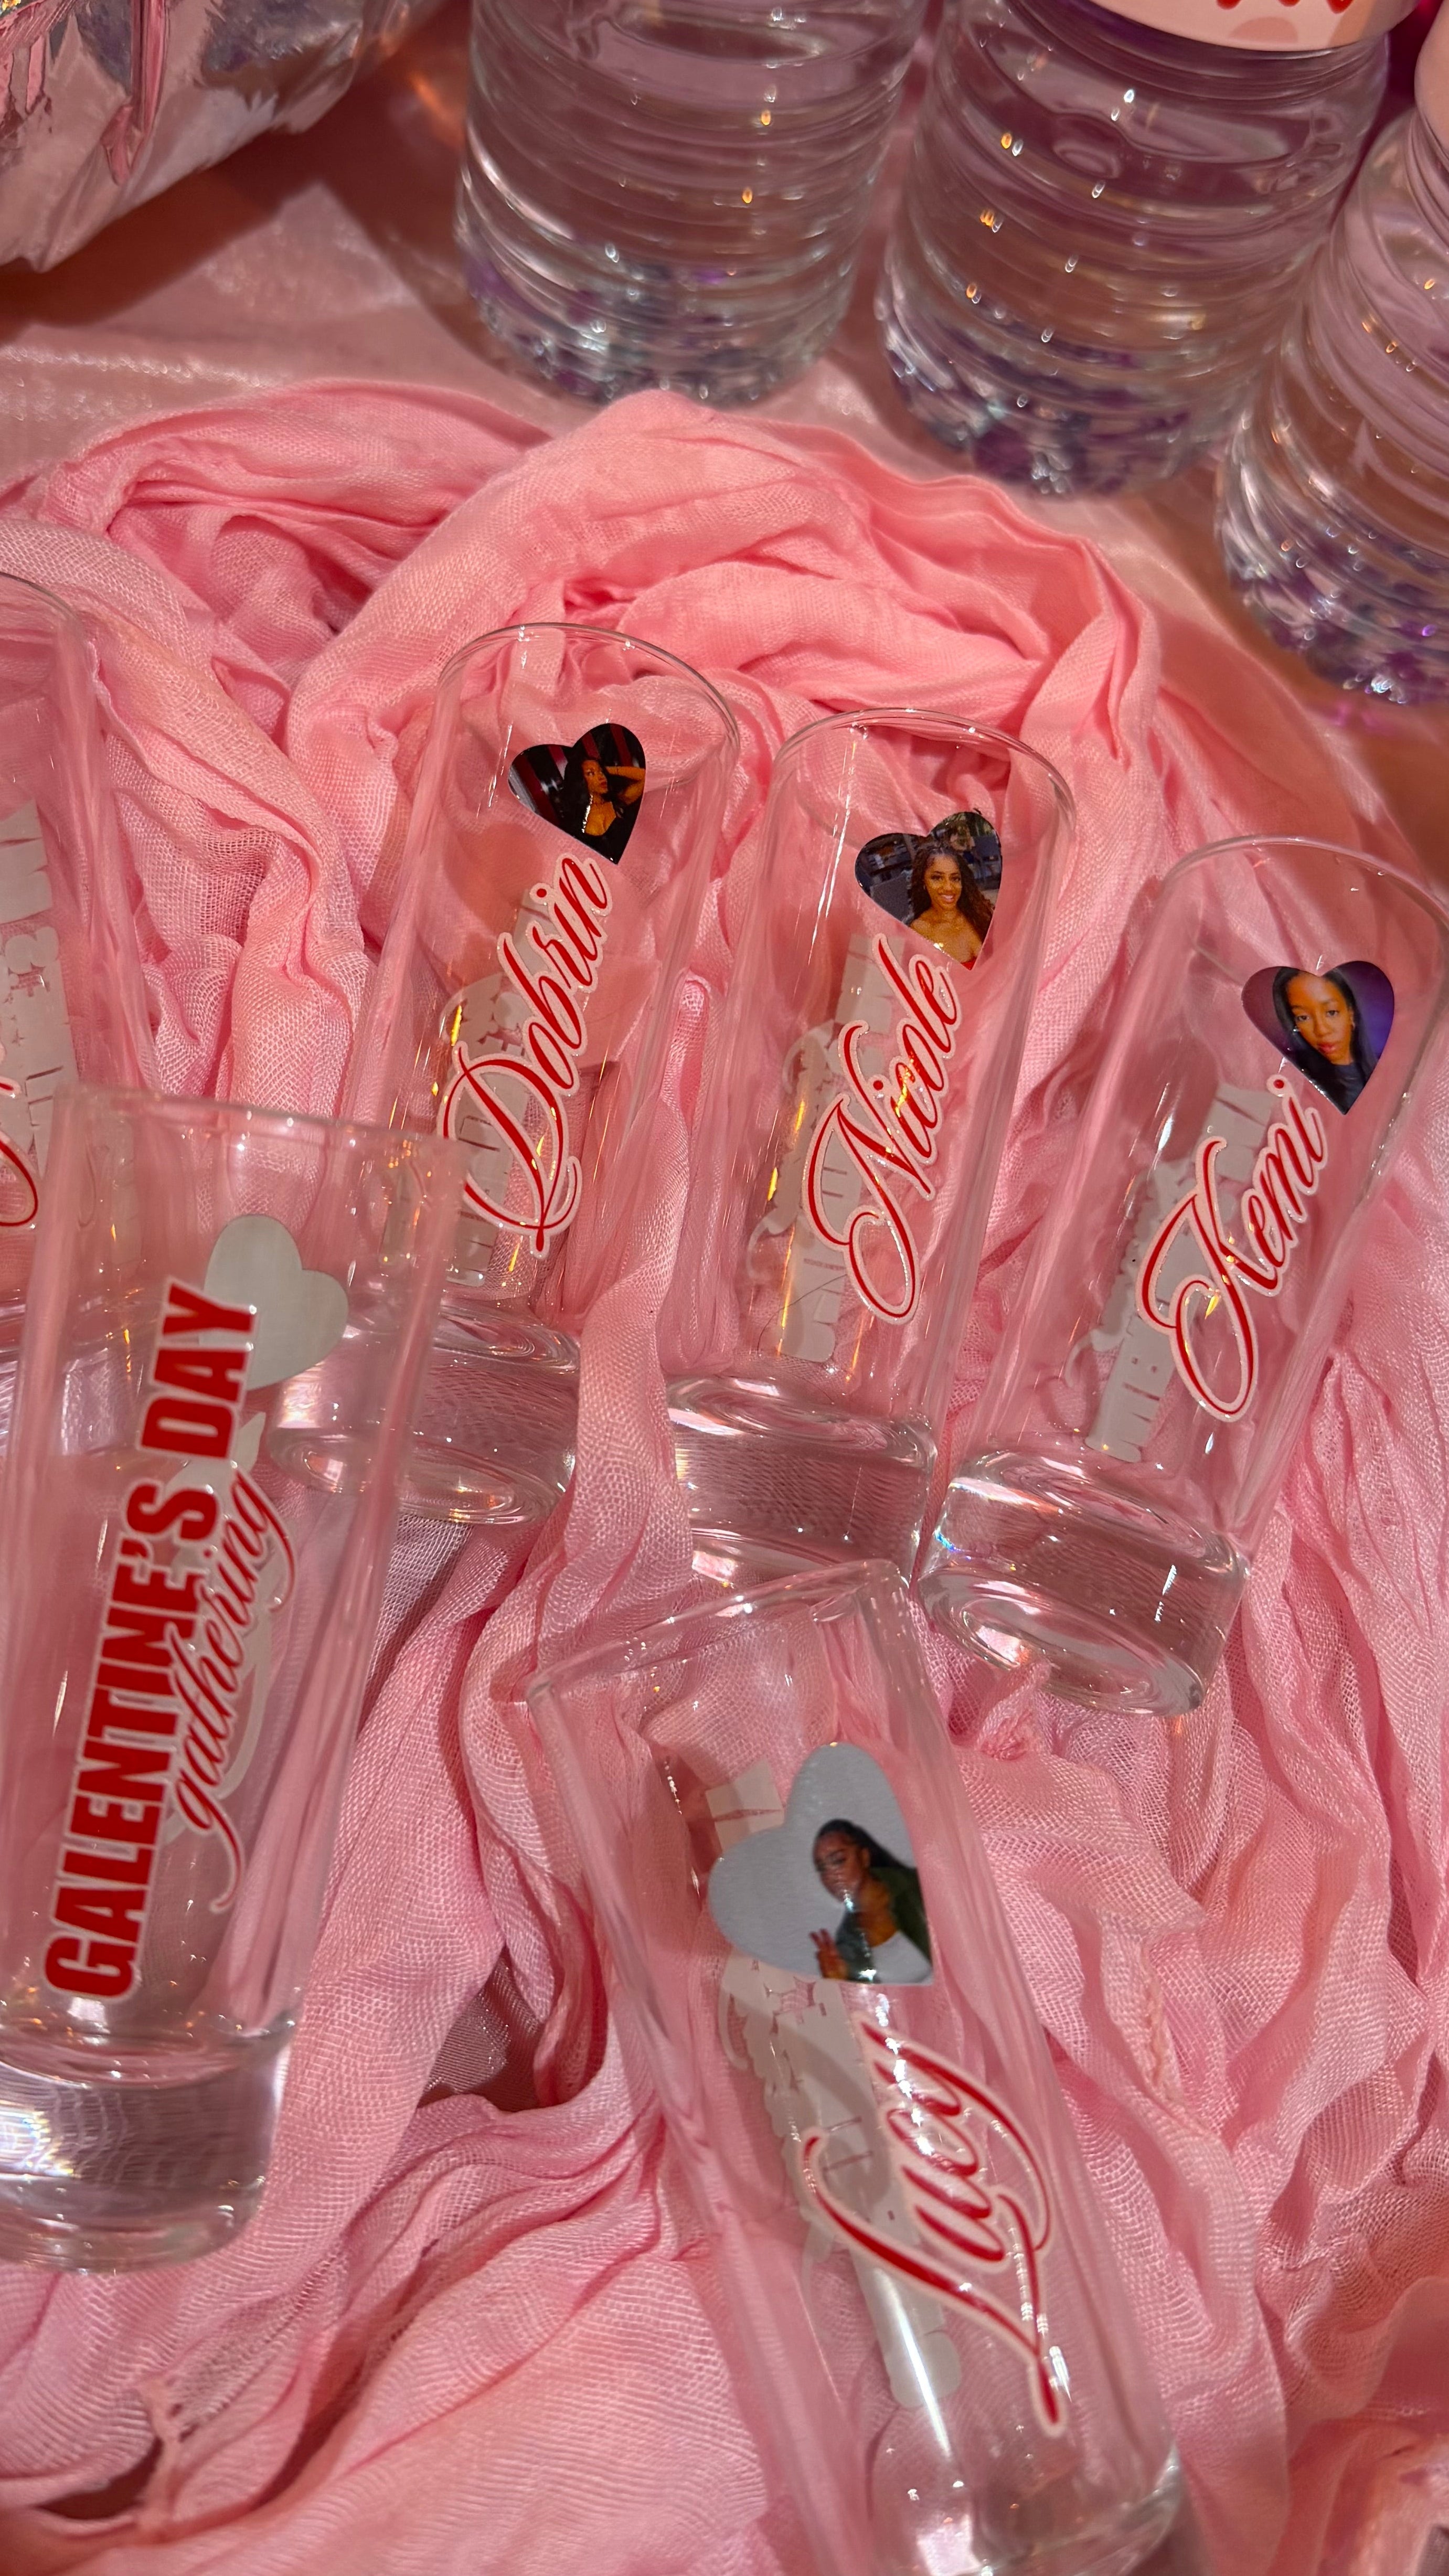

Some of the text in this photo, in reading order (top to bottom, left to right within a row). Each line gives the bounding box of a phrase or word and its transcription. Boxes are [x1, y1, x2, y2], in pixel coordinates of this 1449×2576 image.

[442, 857, 608, 1253] Dobrin
[806, 937, 958, 1318] Nicole
[1141, 1079, 1324, 1415] Kemi
[45, 1280, 257, 1997] GALENTINE'S DAY
[173, 1471, 295, 1910] gathering
[804, 2020, 1059, 2424] Lucy
